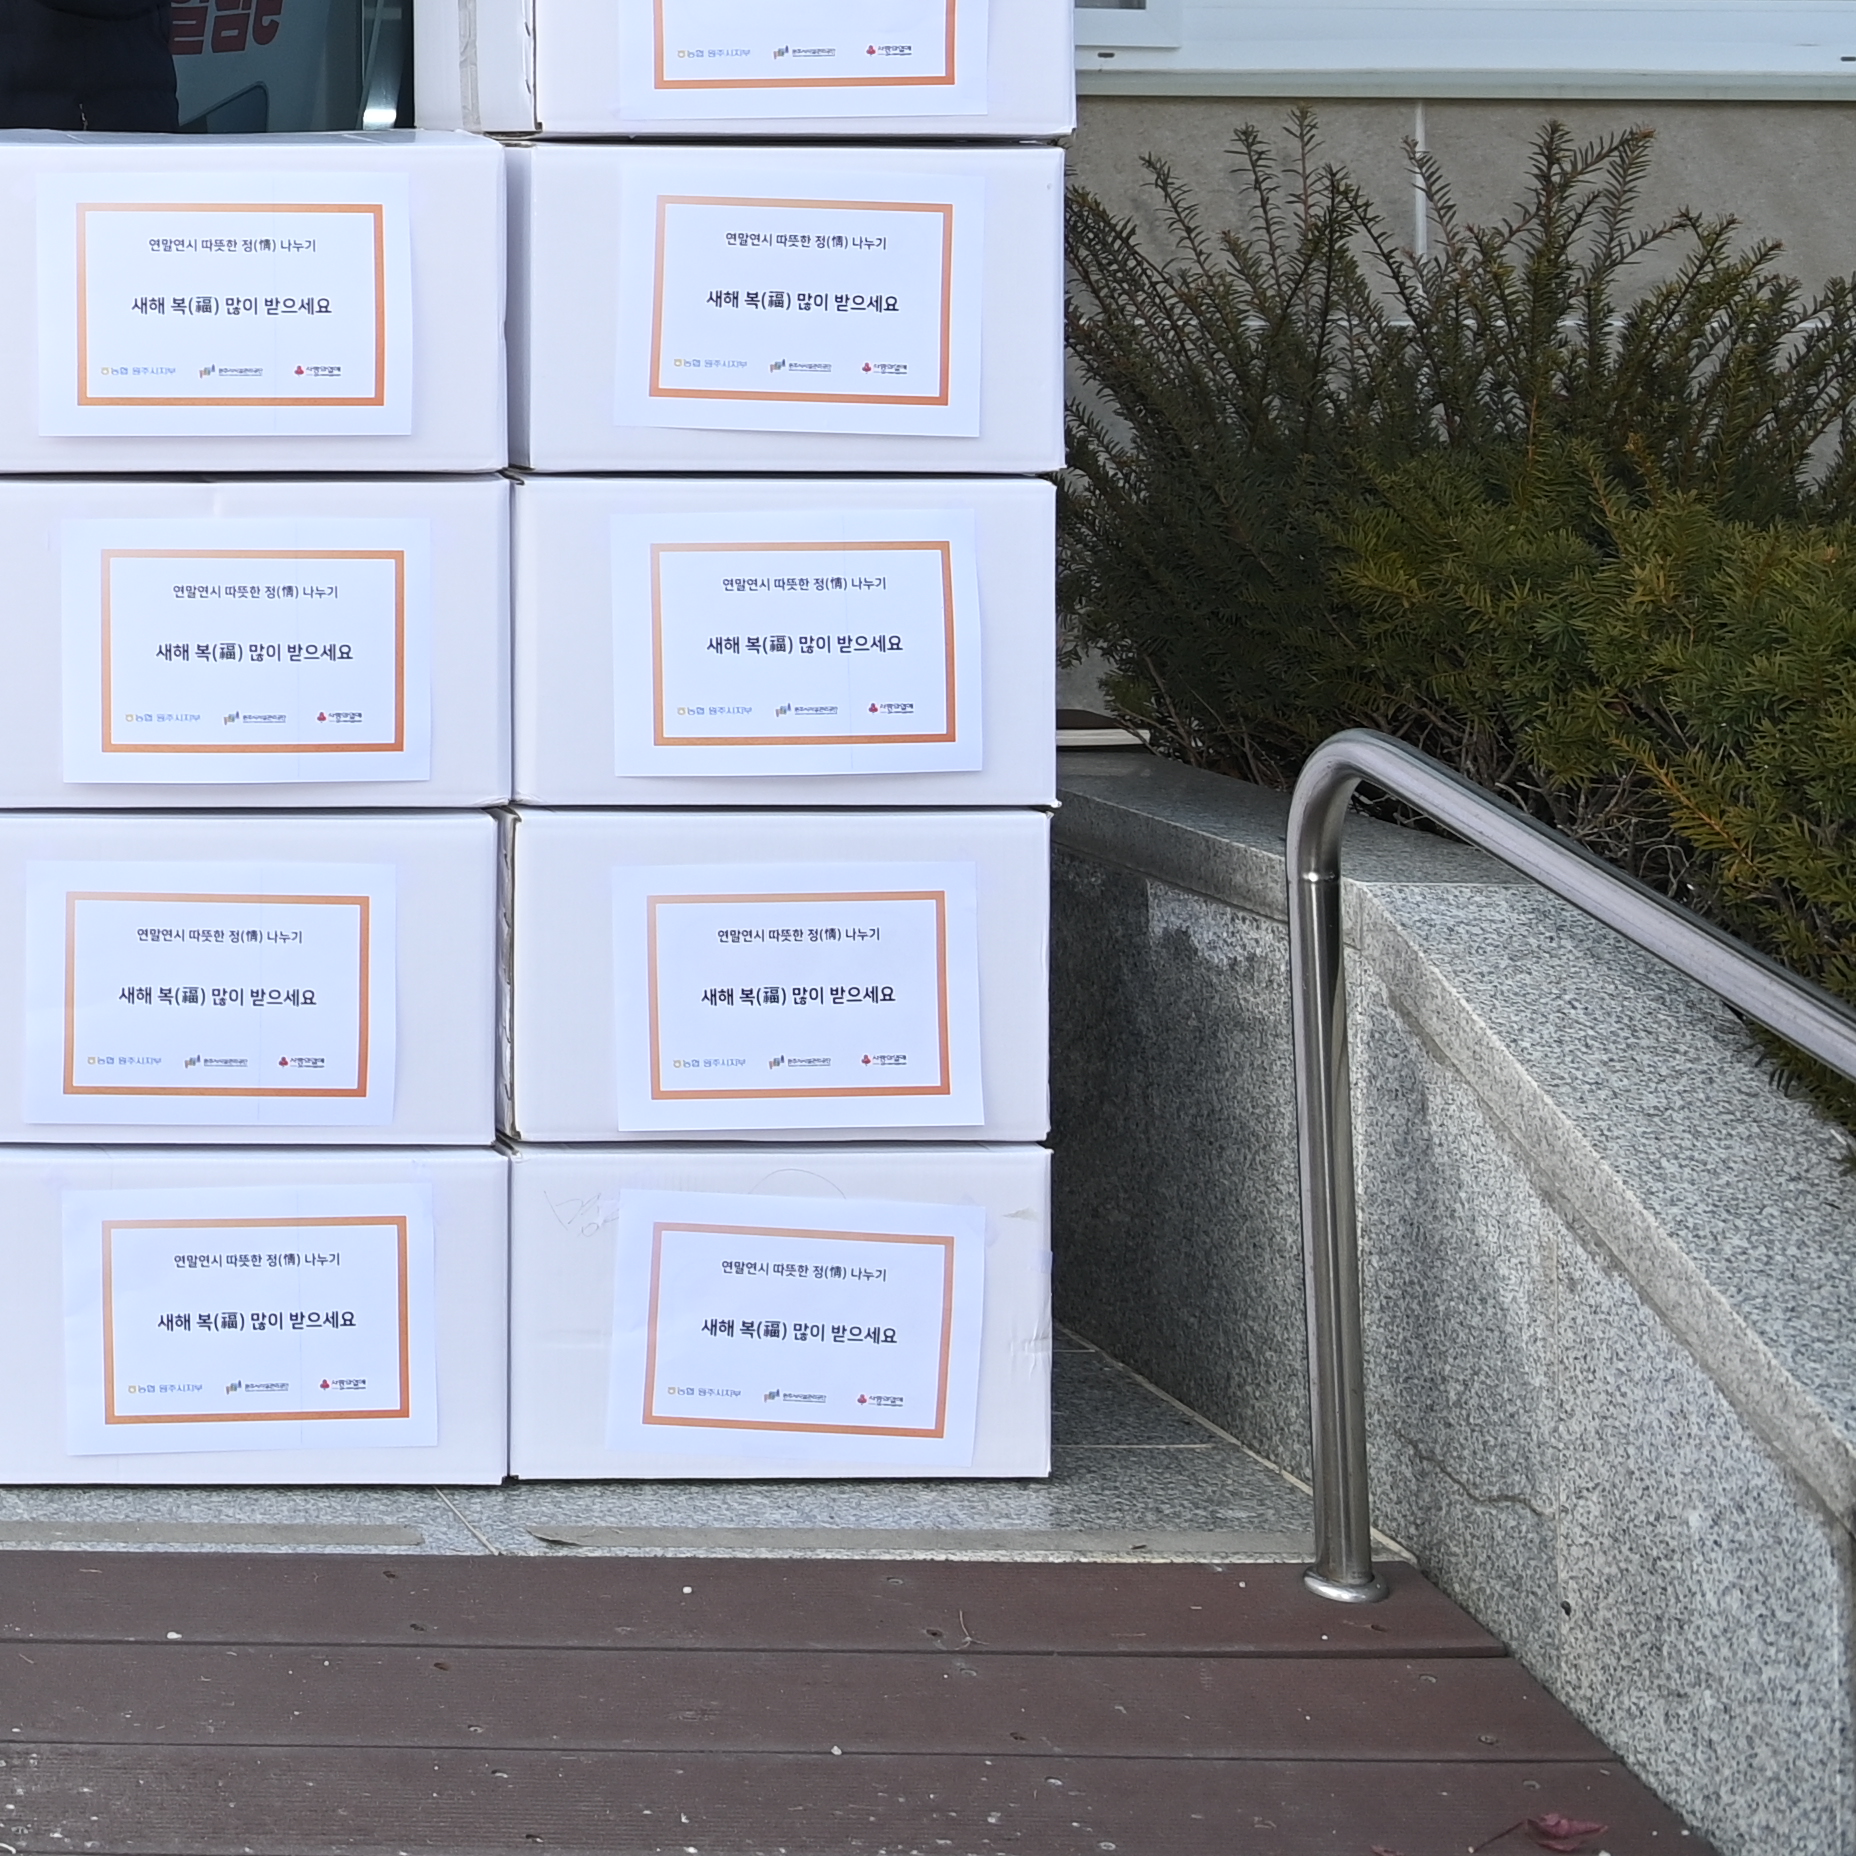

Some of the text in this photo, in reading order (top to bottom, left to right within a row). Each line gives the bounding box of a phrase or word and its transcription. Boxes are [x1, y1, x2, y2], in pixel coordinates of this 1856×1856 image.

[705, 289, 740, 309] 새해
[796, 292, 829, 312] 많이
[834, 293, 900, 314] 받으세요
[706, 635, 741, 655] 새해
[798, 634, 832, 655] 많이
[836, 634, 904, 654] 받으세요
[700, 987, 735, 1007] 새해
[791, 985, 824, 1006] 많이
[829, 985, 897, 1005] 받으세요
[700, 1318, 735, 1338] 새해
[792, 1322, 826, 1343] 많이
[830, 1324, 898, 1345] 받으세요
